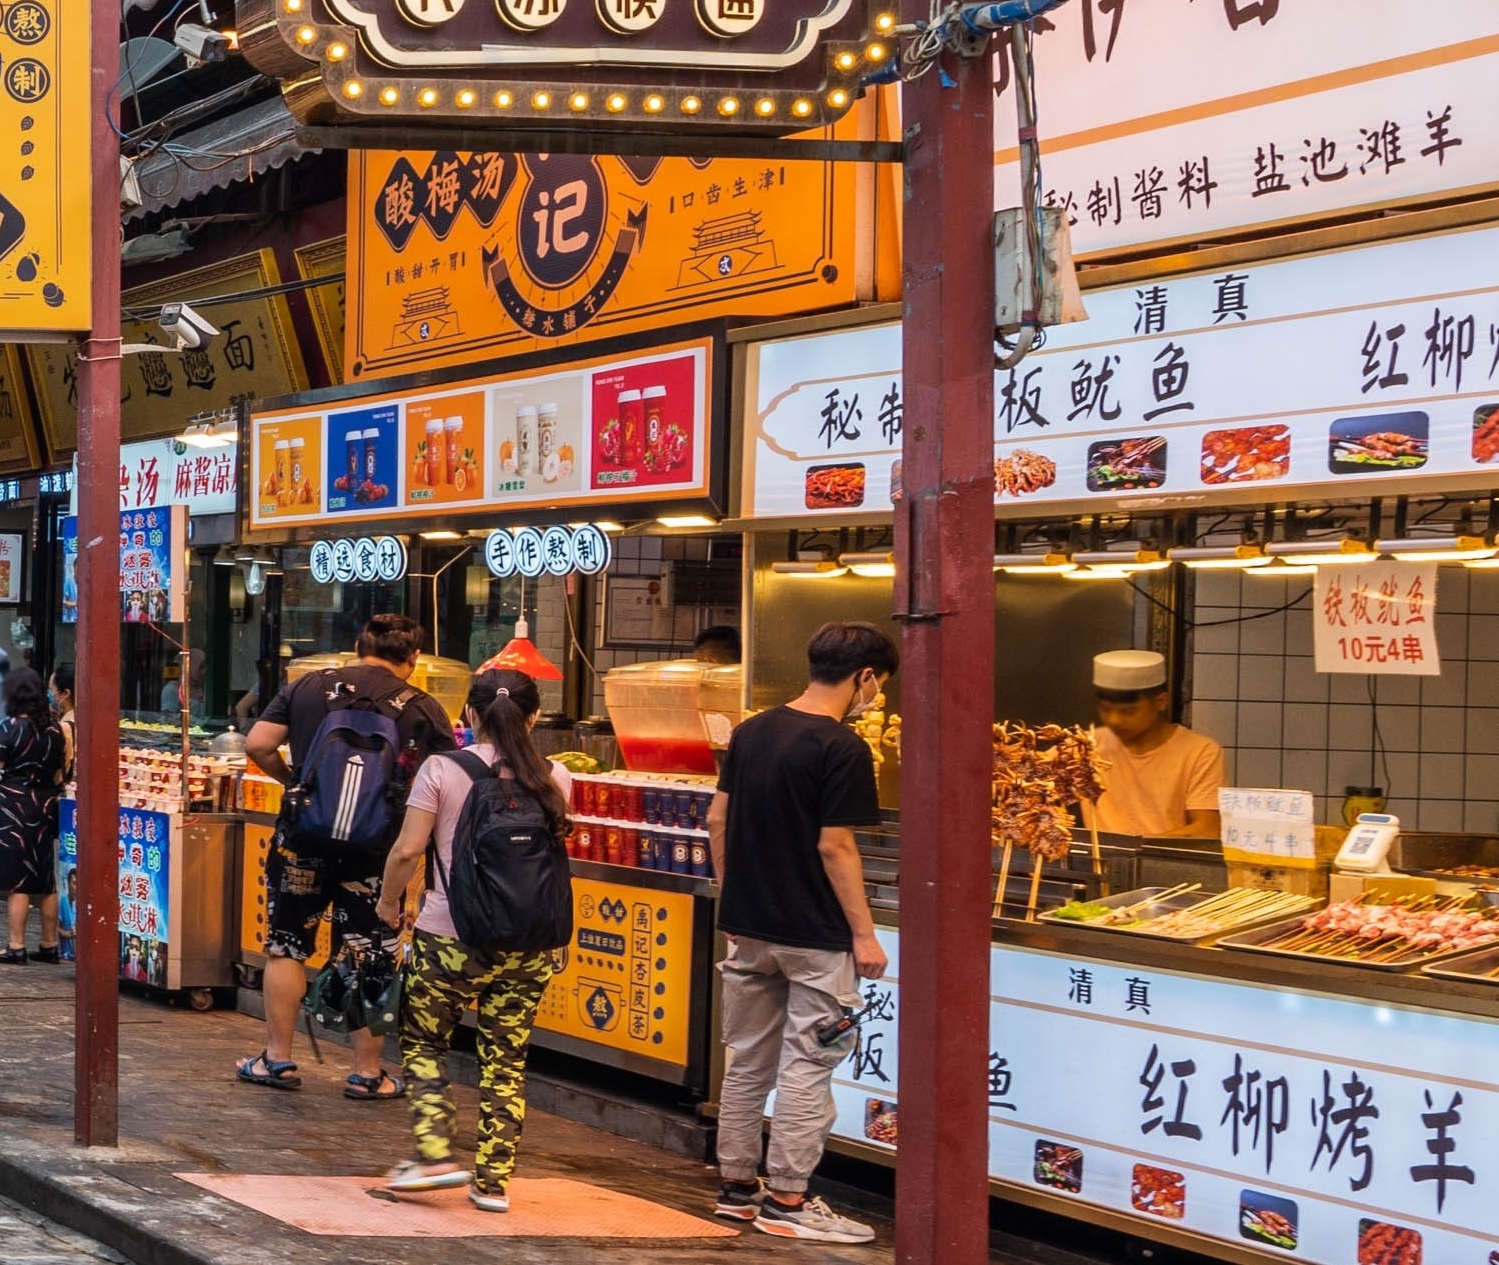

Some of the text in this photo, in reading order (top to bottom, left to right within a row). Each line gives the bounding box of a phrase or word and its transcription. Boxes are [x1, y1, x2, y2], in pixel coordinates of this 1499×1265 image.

[1251, 105, 1463, 199] 盐池滩羊
[1135, 273, 1251, 335] 清真
[1361, 307, 1499, 394] 红柳
[174, 453, 237, 499] 麻酱凉
[313, 543, 398, 579] 精选食材
[491, 532, 598, 568] 手作熬制
[1338, 634, 1425, 665] 10元4串
[1068, 965, 1153, 1017] 清真
[1139, 1041, 1476, 1215] 红柳烤羊
